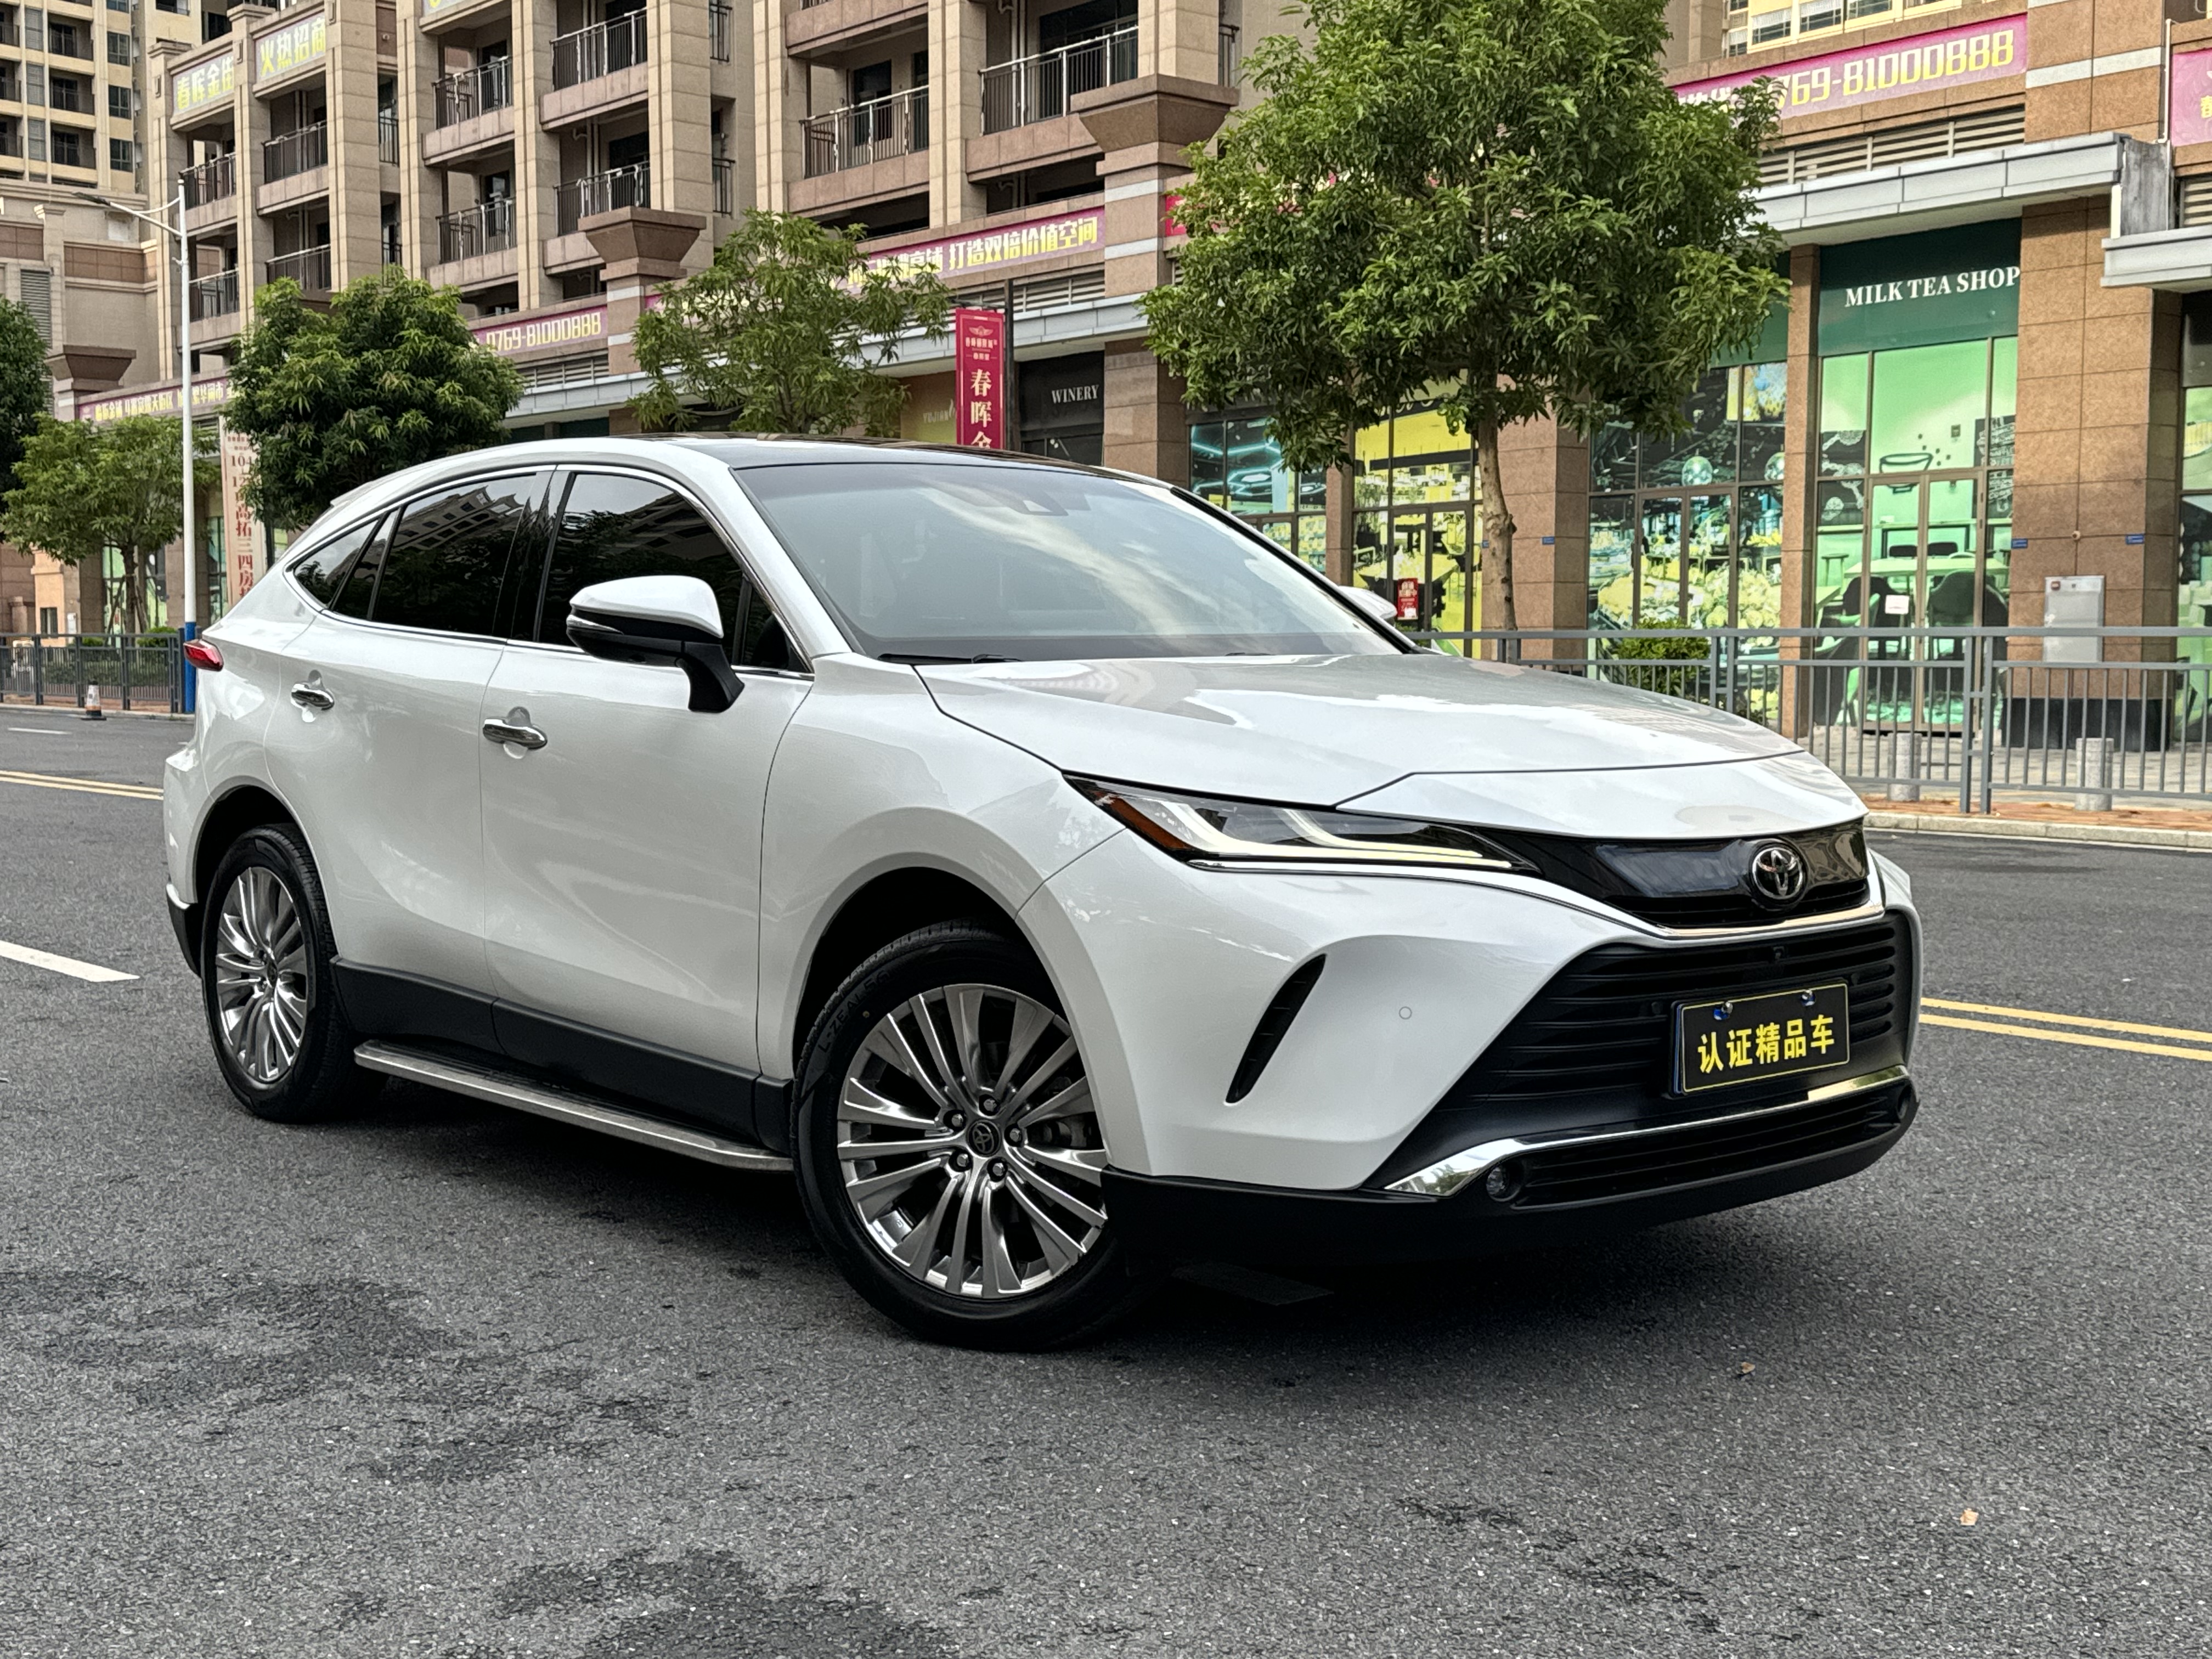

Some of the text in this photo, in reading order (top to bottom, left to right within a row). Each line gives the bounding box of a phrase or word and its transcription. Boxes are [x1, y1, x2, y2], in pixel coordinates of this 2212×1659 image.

[260, 17, 325, 76] 火热招商
[1770, 30, 2014, 109] 769-81000888
[949, 216, 1097, 270] 打造双倍价值空间
[1844, 266, 2021, 307] MILK TEA SHOP
[1051, 385, 1099, 404] WINERY
[1697, 1014, 1835, 1074] 认证精品车
